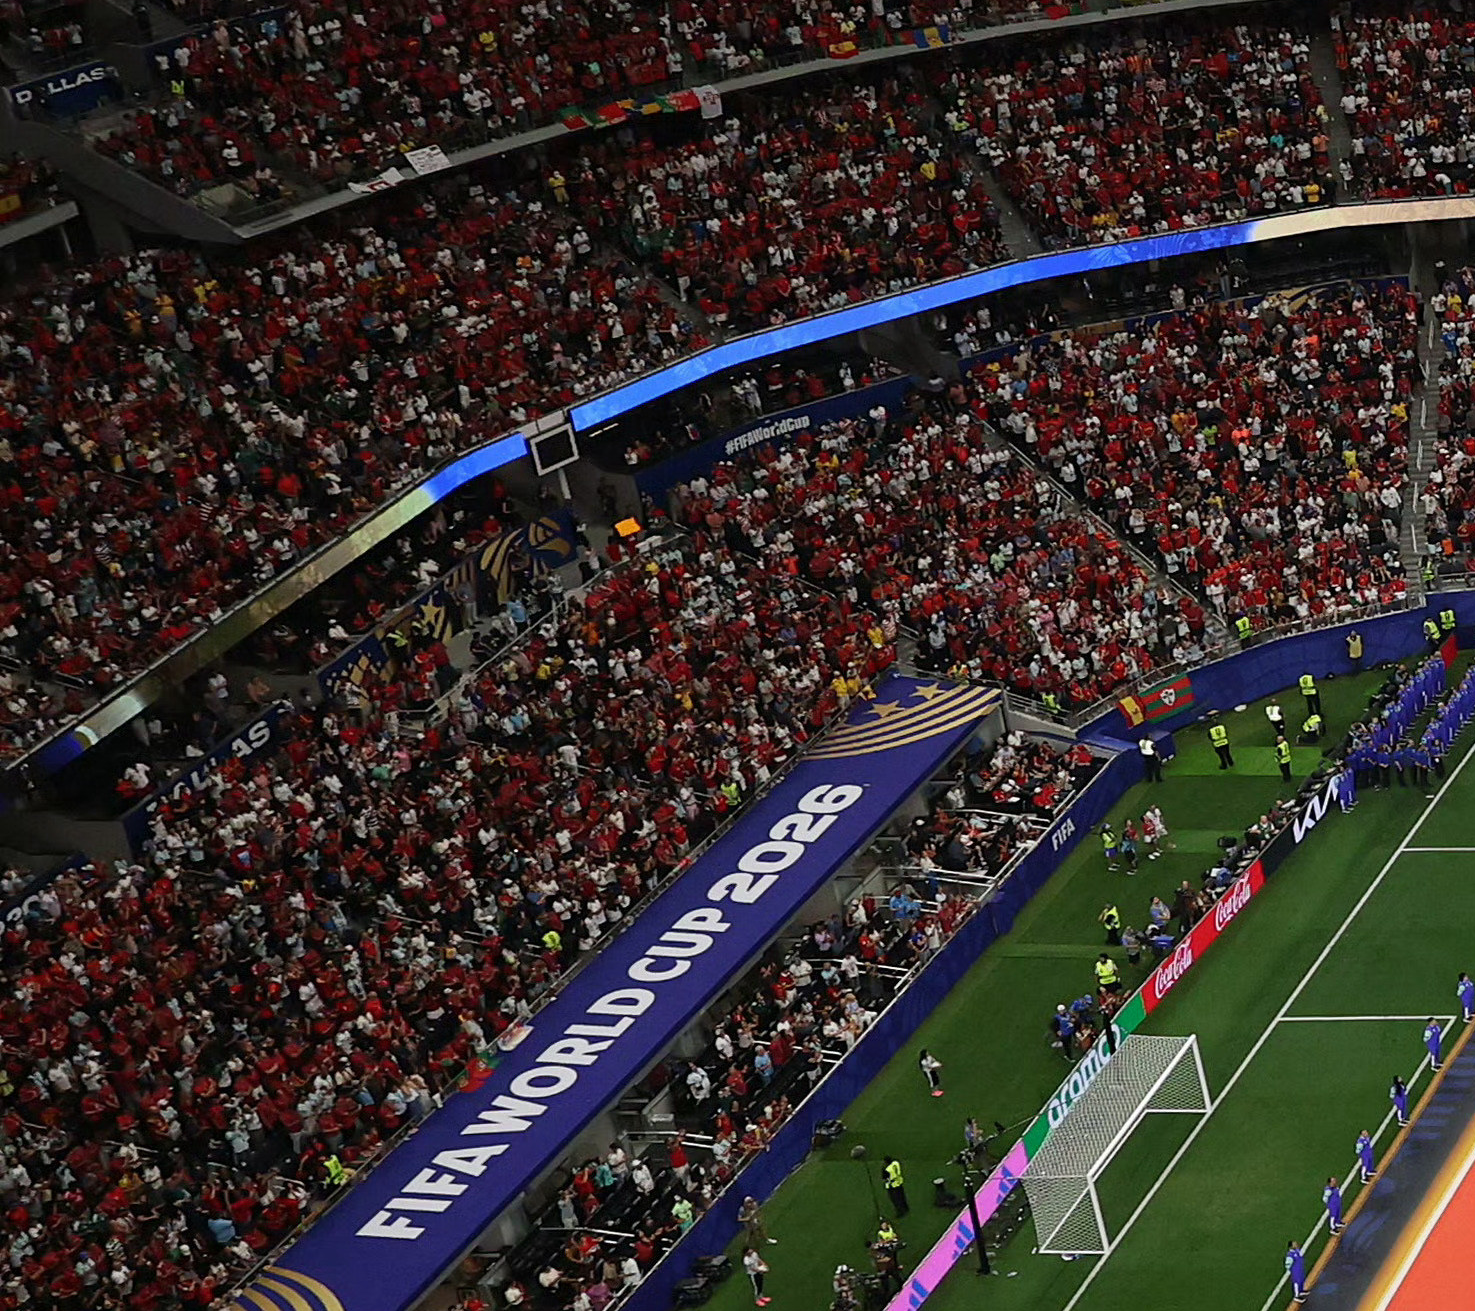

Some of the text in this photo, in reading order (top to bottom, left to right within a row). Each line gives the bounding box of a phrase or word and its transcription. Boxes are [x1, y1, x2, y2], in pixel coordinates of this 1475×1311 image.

[16, 68, 106, 105] DLLAS
[725, 416, 810, 456] #FIFAWorldCup
[1052, 817, 1076, 851] FIFA
[355, 784, 865, 1239] FIFA WORLD CUP 2026
